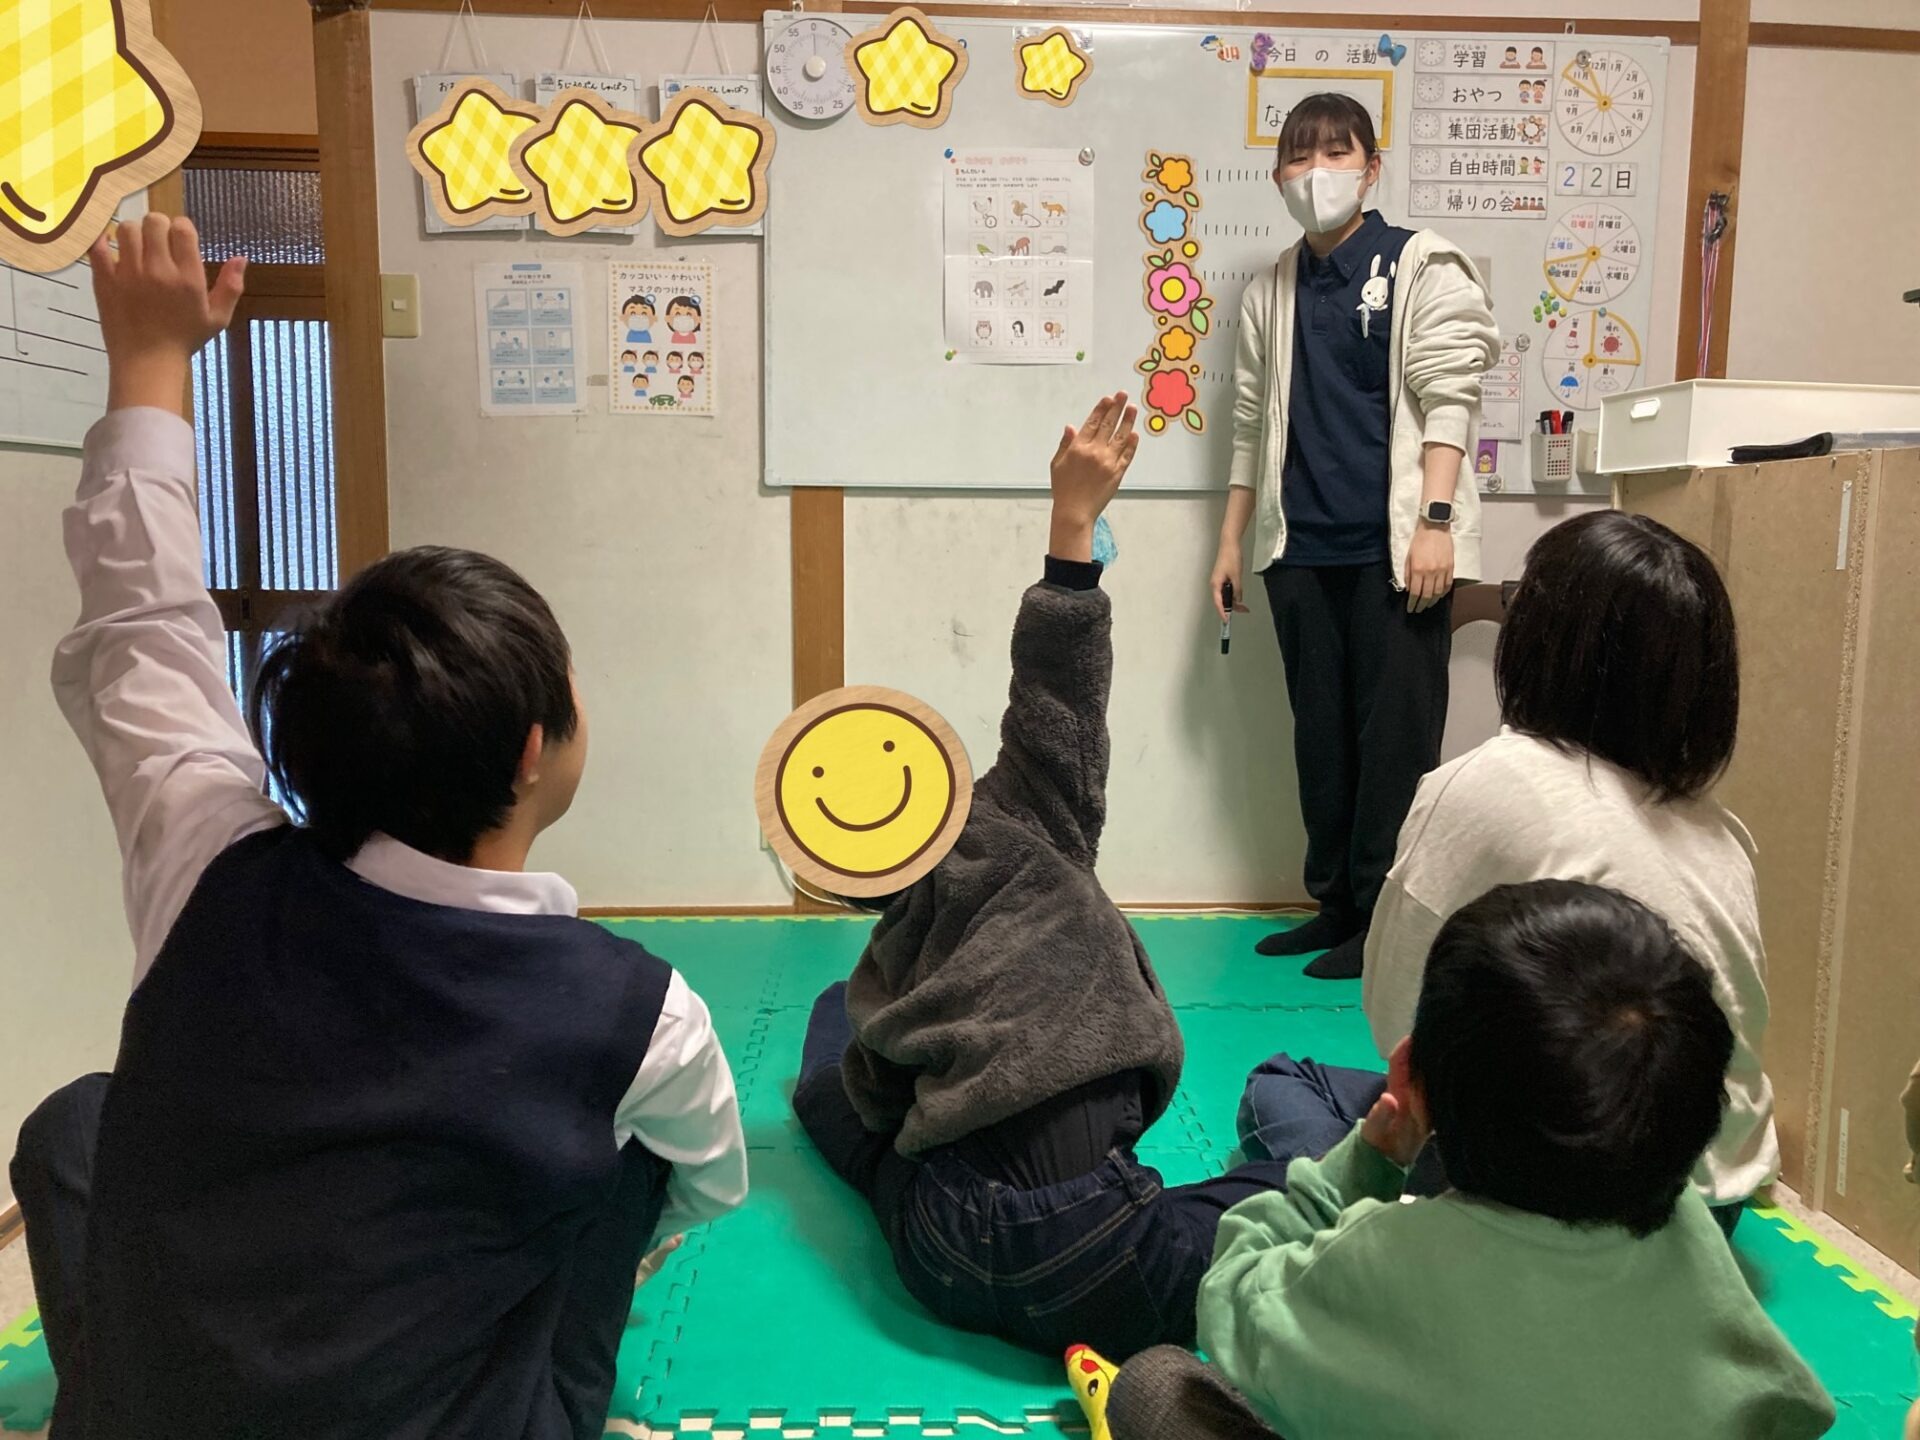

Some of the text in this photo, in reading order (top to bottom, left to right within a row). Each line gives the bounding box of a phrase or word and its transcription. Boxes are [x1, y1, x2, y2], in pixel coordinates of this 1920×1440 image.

[811, 23, 816, 31] 0
[788, 29, 799, 37] 55
[831, 28, 837, 36] 5
[774, 45, 785, 53] 50
[1268, 48, 1377, 64] 今日 の 活動
[1453, 50, 1486, 68] 学習
[770, 66, 781, 74] 45
[1591, 62, 1606, 71] 12月
[1611, 63, 1622, 72] 1月
[1574, 71, 1588, 80] 11月
[1626, 73, 1638, 82] 2月
[777, 87, 788, 95] 40
[1452, 88, 1502, 103] おやつ
[1564, 89, 1579, 98] 10月
[1633, 91, 1644, 100] 3月
[793, 101, 803, 110] 35
[833, 100, 843, 109] 25
[813, 106, 824, 115] 30
[1566, 107, 1578, 116] 9月
[1265, 104, 1292, 128] な
[1632, 112, 1643, 121] 4月
[1448, 123, 1516, 140] 集団活動
[1571, 125, 1582, 134] 8月
[1621, 128, 1632, 138] 5月
[1587, 134, 1598, 143] 7月
[1603, 136, 1615, 144] 6月
[1450, 159, 1516, 176] 自由時間
[1447, 195, 1515, 212] 帰りの会
[1599, 220, 1621, 229] 月曜日
[1549, 242, 1573, 250] 土曜日
[1612, 245, 1636, 254] 火曜日
[620, 272, 705, 281] カッコいい・かわいい
[1606, 272, 1629, 281] 水曜日
[628, 285, 696, 294] マスクのつけかた
